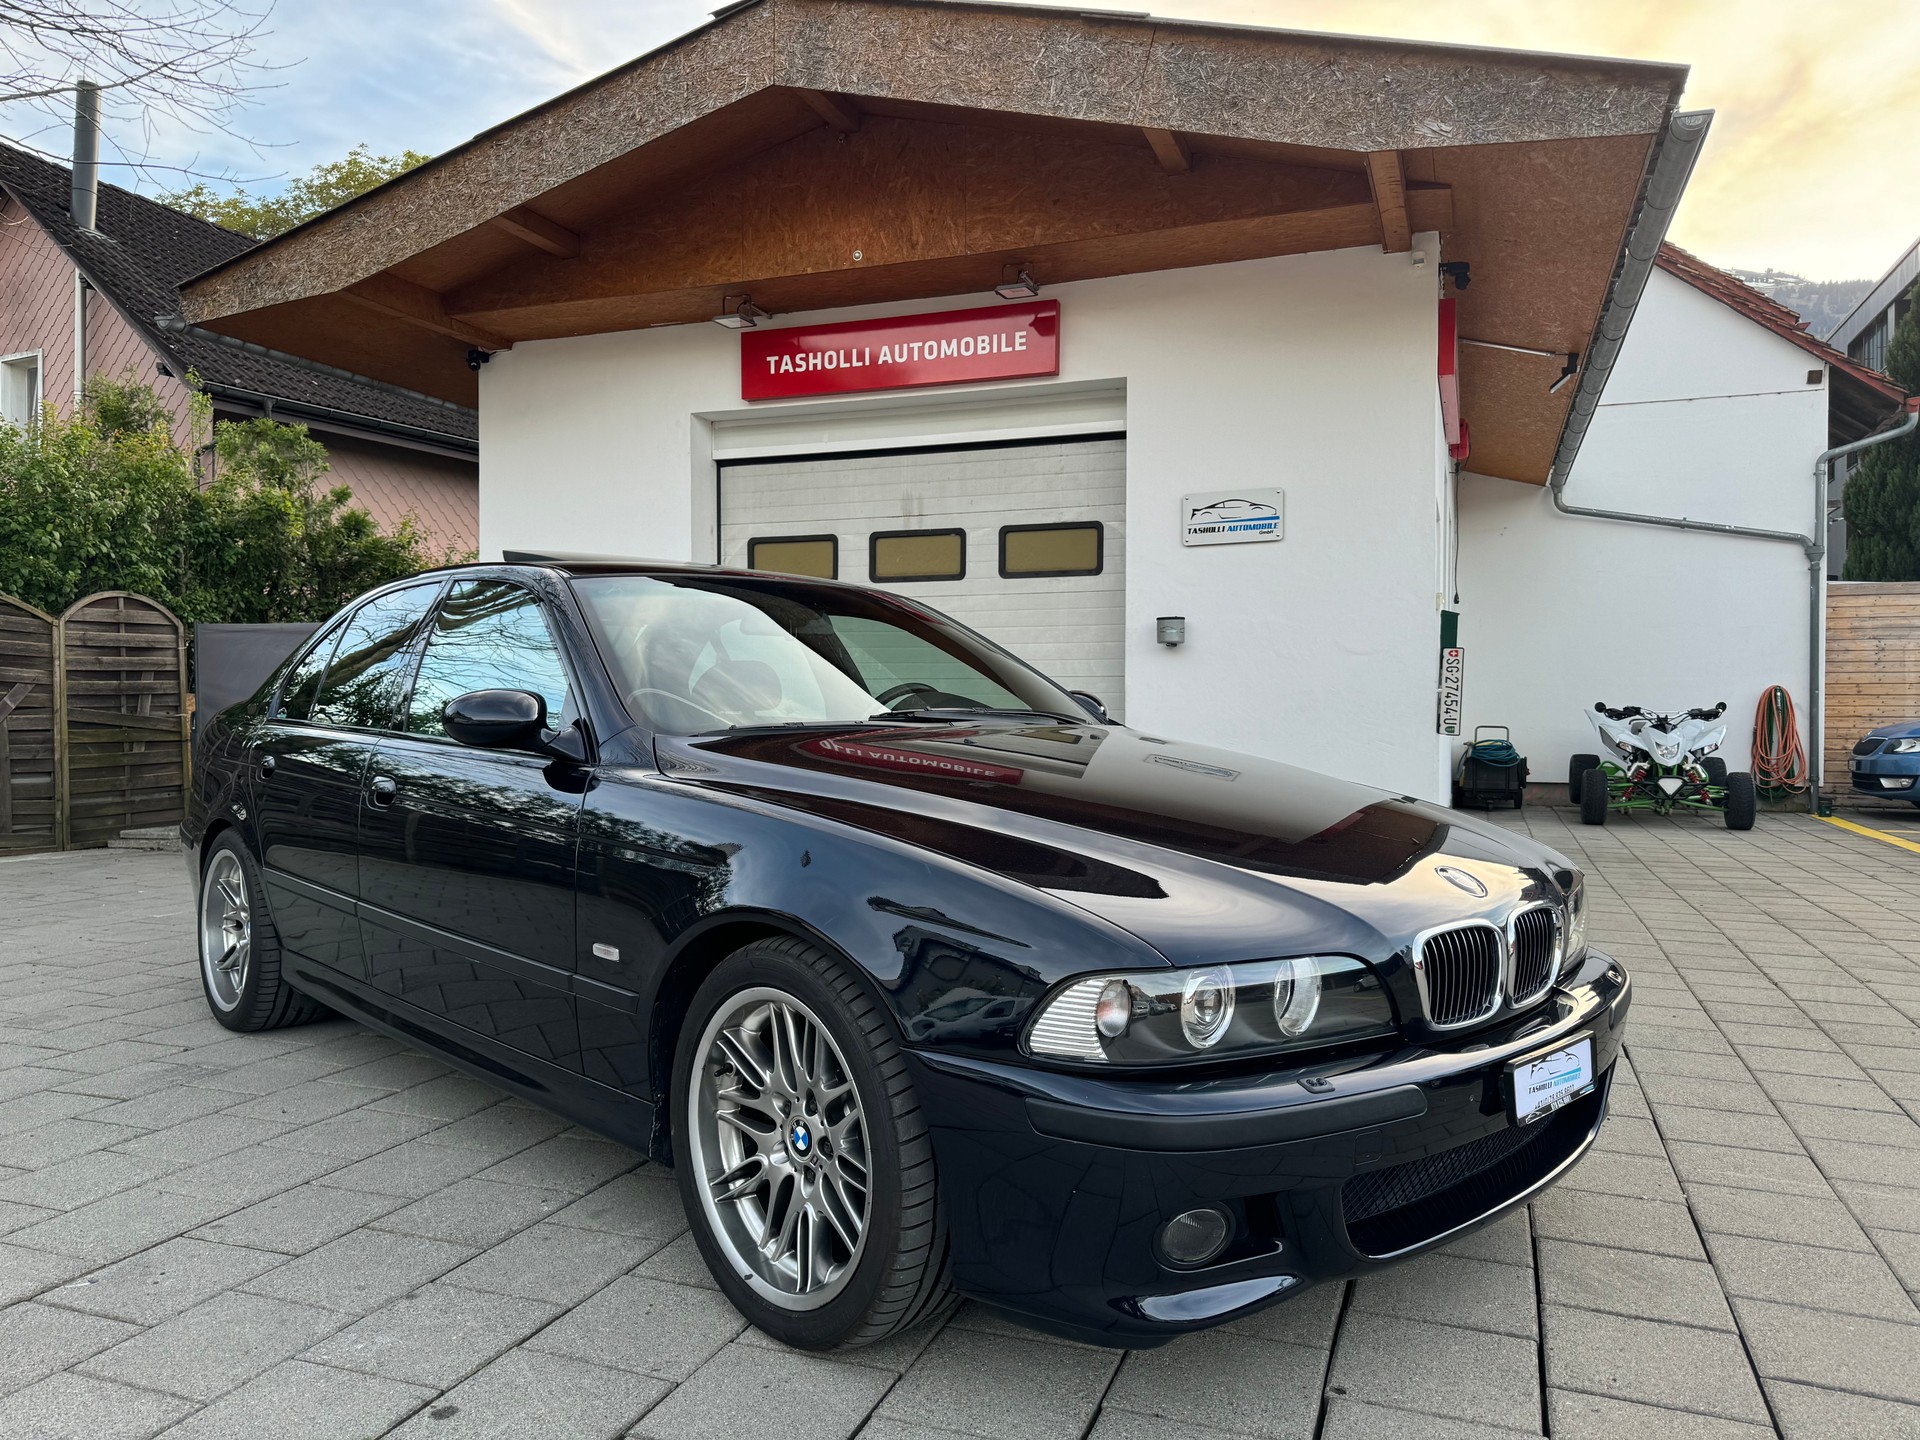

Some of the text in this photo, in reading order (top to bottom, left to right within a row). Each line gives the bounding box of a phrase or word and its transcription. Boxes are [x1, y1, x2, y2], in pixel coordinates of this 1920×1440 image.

[766, 331, 1027, 375] TASHOLLI AUTOMOBILE
[1187, 522, 1279, 535] TASHOLLI AUTOMOBILE
